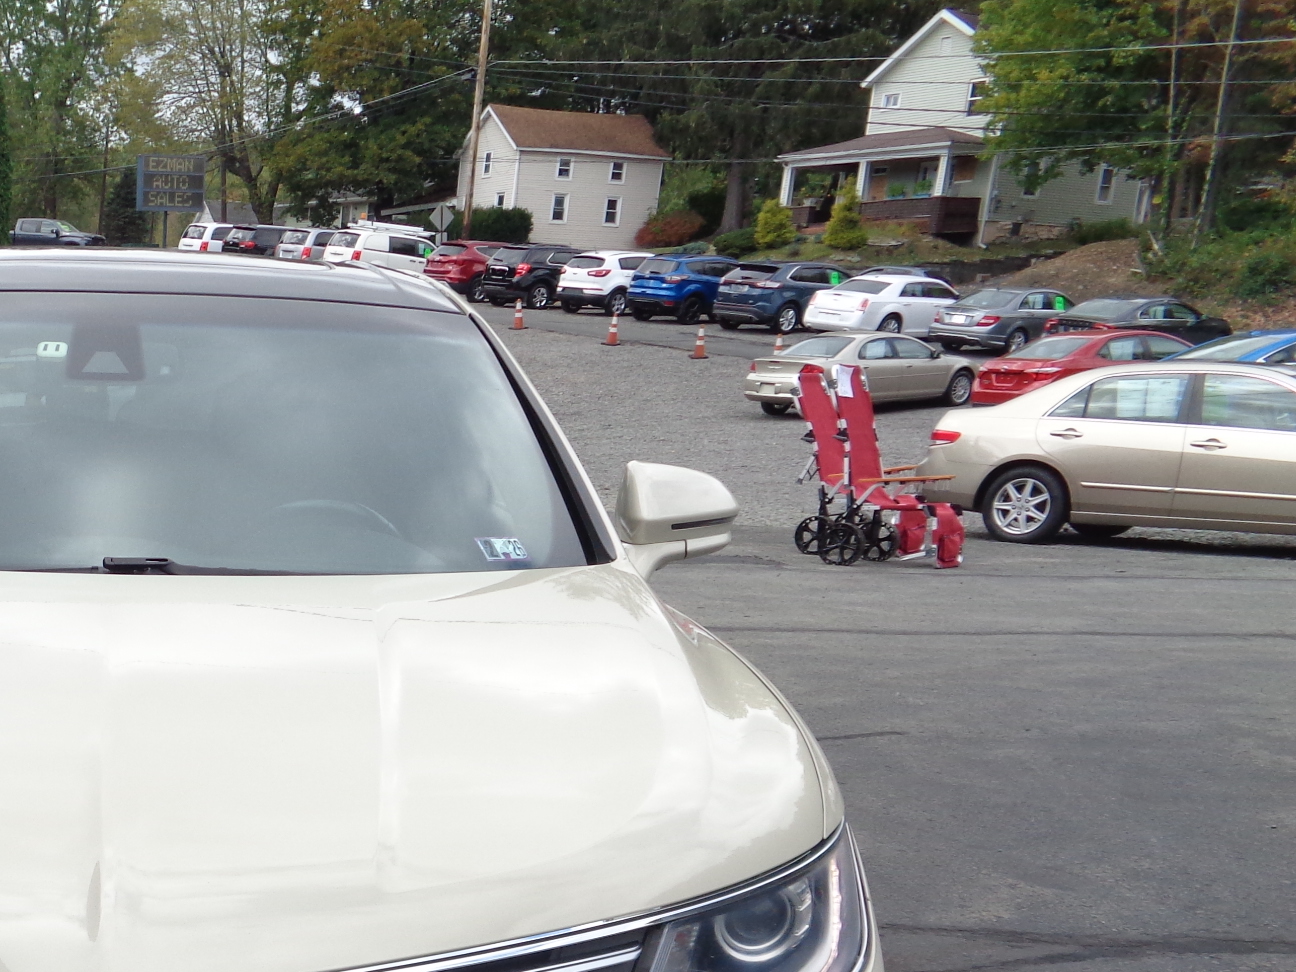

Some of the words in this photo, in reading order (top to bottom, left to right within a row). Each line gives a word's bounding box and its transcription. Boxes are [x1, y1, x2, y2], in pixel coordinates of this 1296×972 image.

[148, 157, 194, 172] EZMAN
[153, 175, 189, 190] AUTO
[148, 192, 192, 207] SALES
